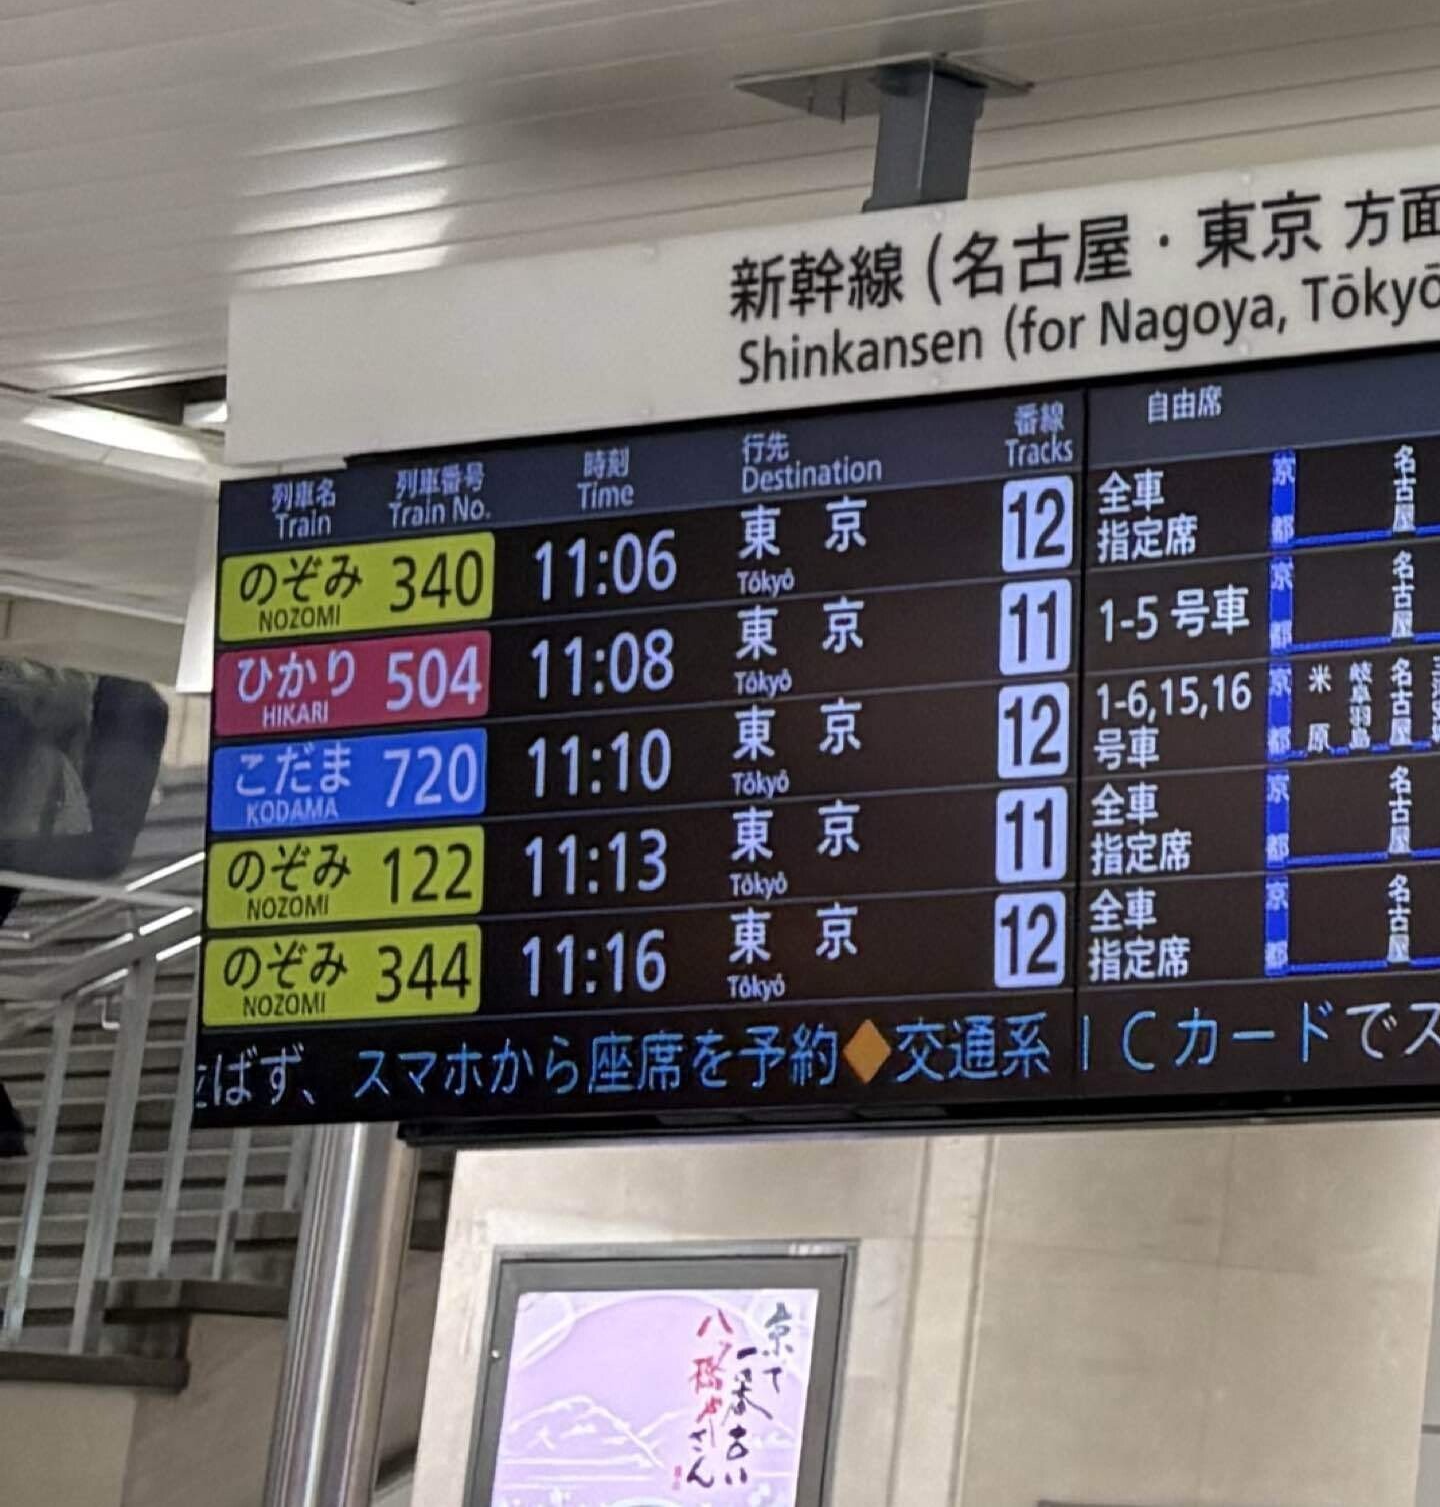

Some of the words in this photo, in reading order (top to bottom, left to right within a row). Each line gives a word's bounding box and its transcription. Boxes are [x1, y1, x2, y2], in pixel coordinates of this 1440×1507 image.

[731, 243, 904, 323] 新幹線
[740, 322, 983, 386] Shinkansen
[1004, 304, 1085, 361] (for
[1100, 290, 1288, 348] Nagoya,
[1014, 402, 1065, 436] 番線
[1147, 385, 1223, 424] 自由席
[583, 446, 631, 479] 時刻
[742, 431, 790, 464] 行先
[1005, 434, 1074, 469] Tracks
[271, 477, 337, 512] 列車名
[396, 461, 486, 499] 列車番号
[578, 480, 635, 511] Time
[742, 455, 882, 494] Destination
[1098, 468, 1166, 515] 全車
[276, 510, 332, 540] Train
[389, 498, 446, 529] Train
[453, 493, 492, 524] No.
[1007, 486, 1066, 560] 12
[1097, 514, 1199, 563] 指定席
[239, 554, 363, 606] のぞみ
[389, 549, 484, 614] 340
[534, 529, 677, 601] 11:06
[258, 605, 342, 633] NOZOMI
[1007, 590, 1062, 664] 11
[1099, 595, 1159, 643] 1-5
[1170, 584, 1250, 638] 号車
[236, 649, 356, 704] ひかり
[386, 645, 482, 712] 504
[531, 628, 675, 700] 11:08
[261, 700, 330, 728] HIKARI
[1004, 694, 1062, 768] 12
[528, 729, 672, 798] 11:10
[1093, 725, 1160, 772] 号車
[234, 744, 352, 797] こだま
[383, 741, 480, 809] 720
[246, 798, 339, 826] KODAMA
[1004, 798, 1054, 870] 11
[228, 843, 351, 894] のぞみ
[383, 842, 474, 904] 122
[525, 829, 668, 898] 11:13
[246, 893, 330, 921] NOZOMI
[522, 929, 666, 998] 11:16
[1000, 903, 1058, 976] 12
[223, 940, 347, 990] のぞみ
[375, 941, 472, 1005] 344
[242, 991, 326, 1019] NOZOMI
